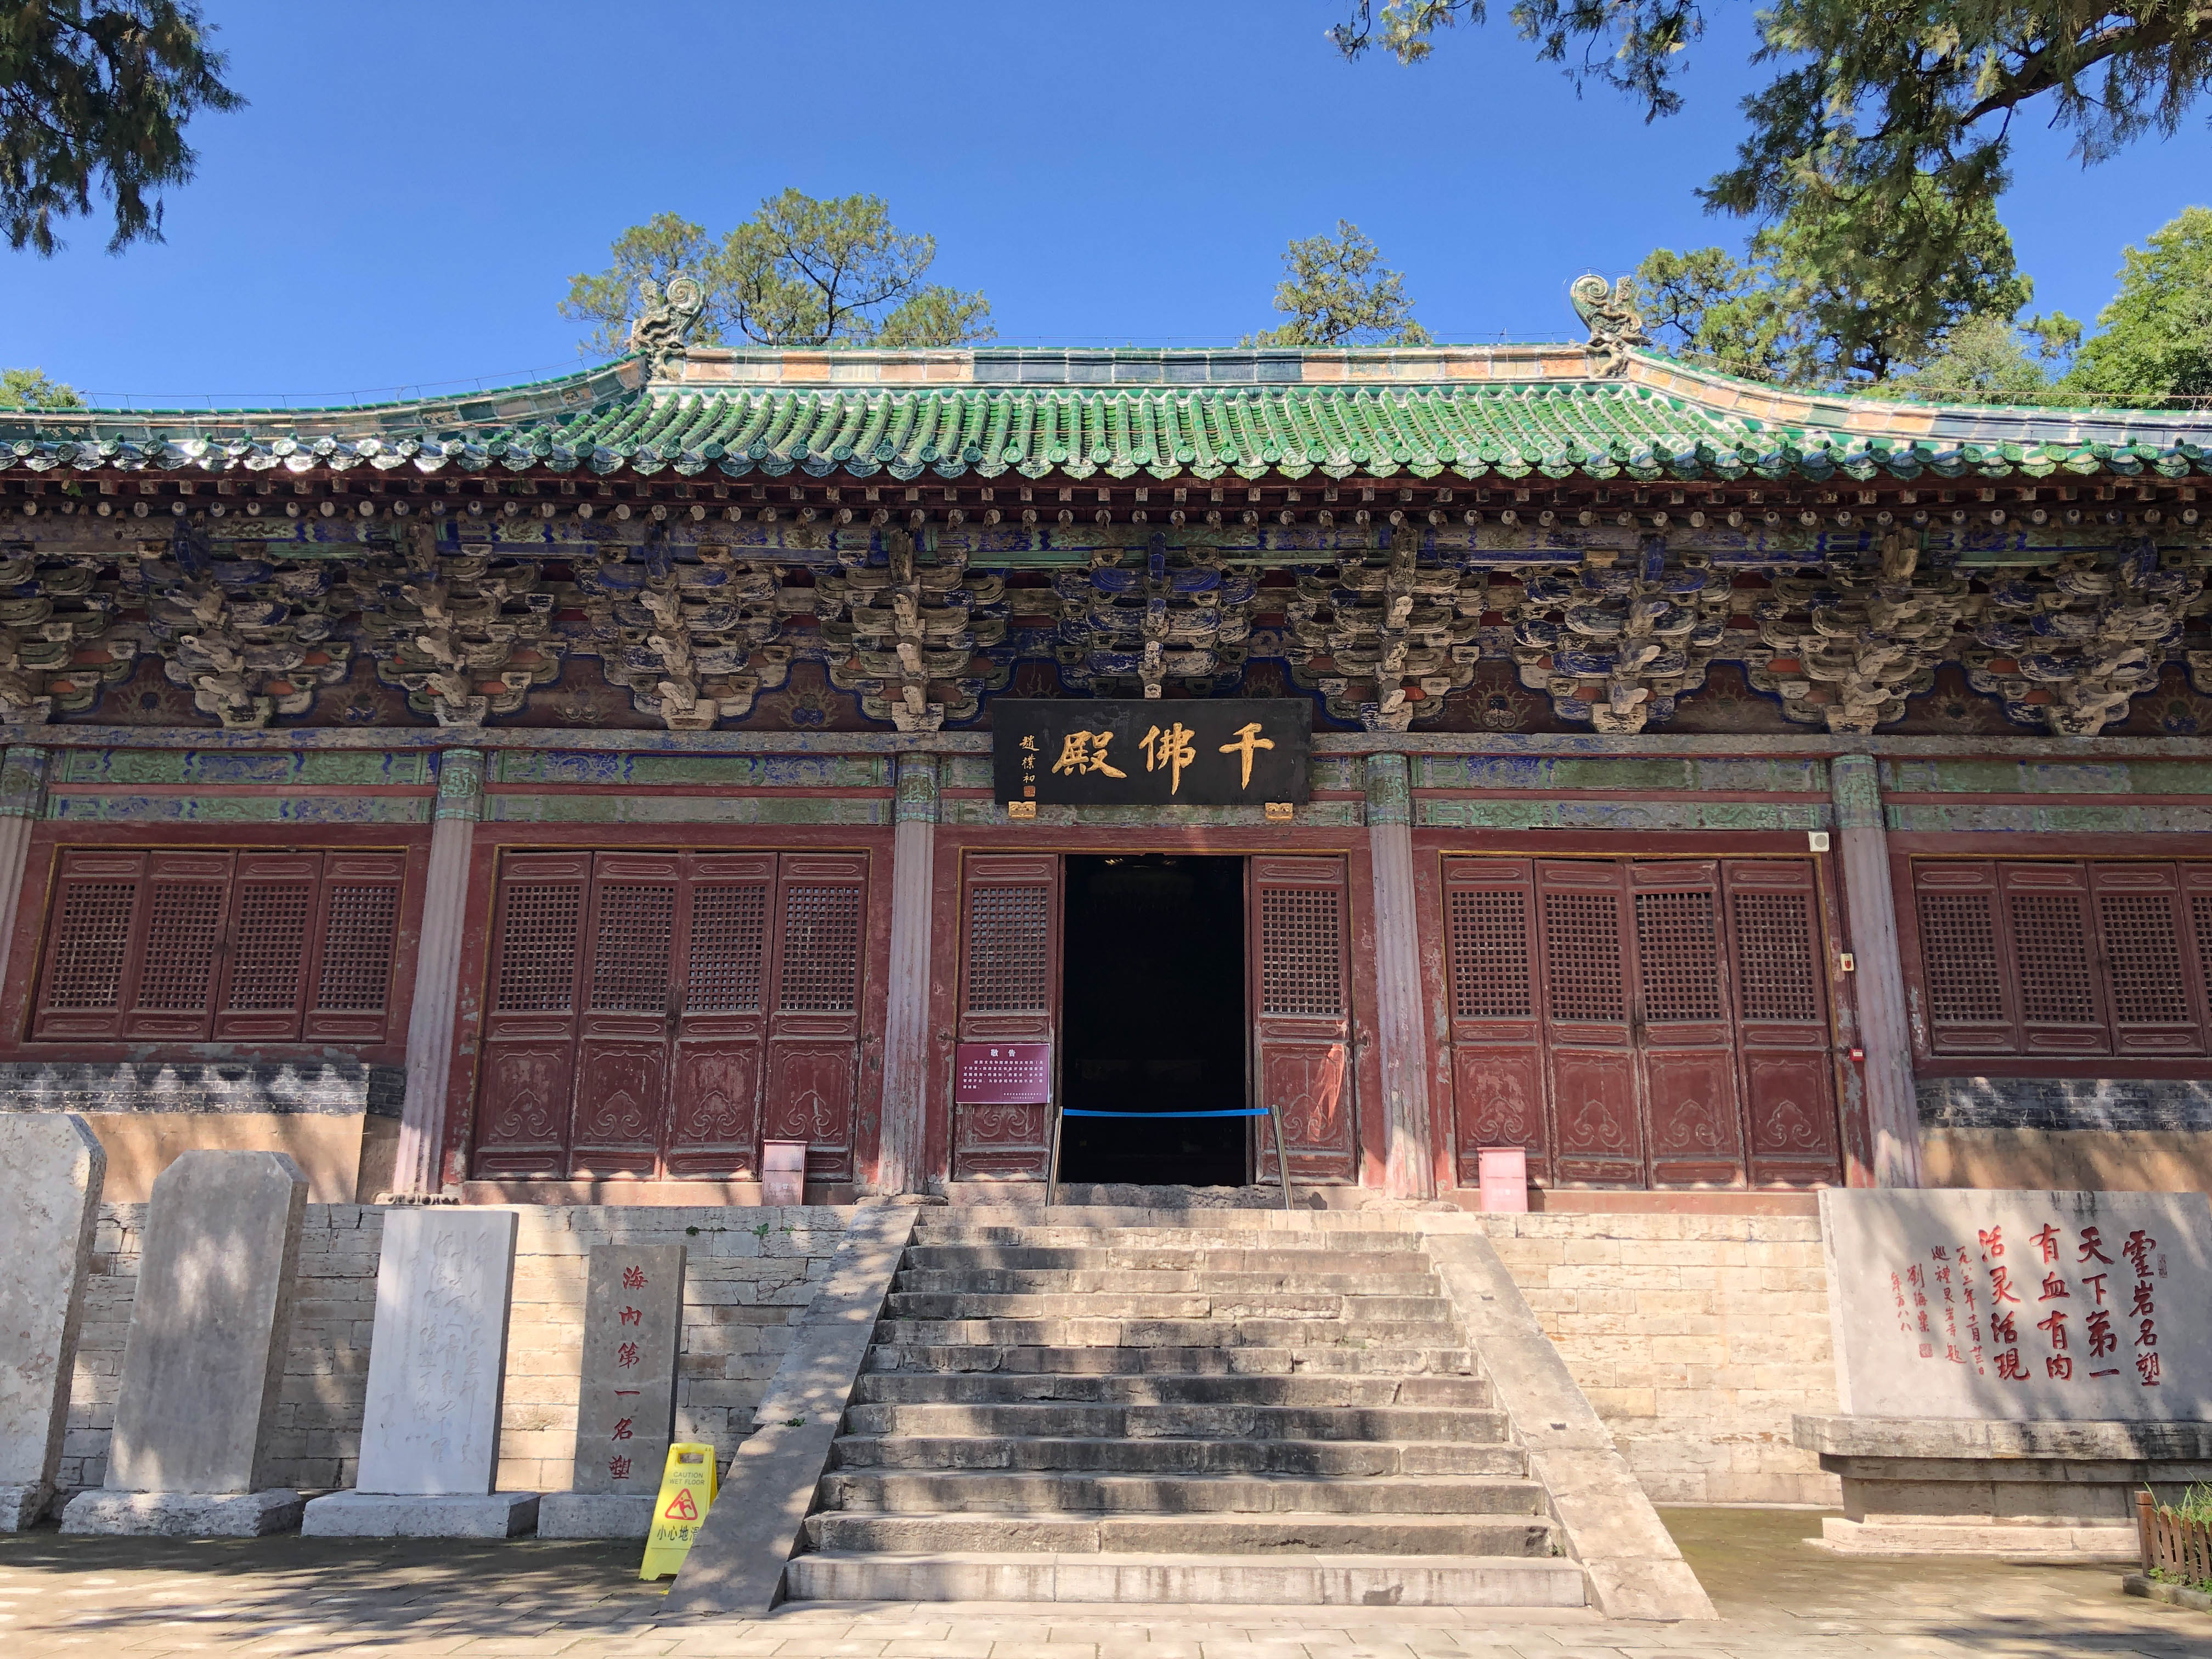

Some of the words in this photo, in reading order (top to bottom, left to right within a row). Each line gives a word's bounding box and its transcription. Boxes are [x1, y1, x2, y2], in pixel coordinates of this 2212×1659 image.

[1052, 721, 1276, 795] 千佛殿
[2029, 1223, 2074, 1381] 有血有肉
[2076, 1226, 2120, 1378] 天下第一
